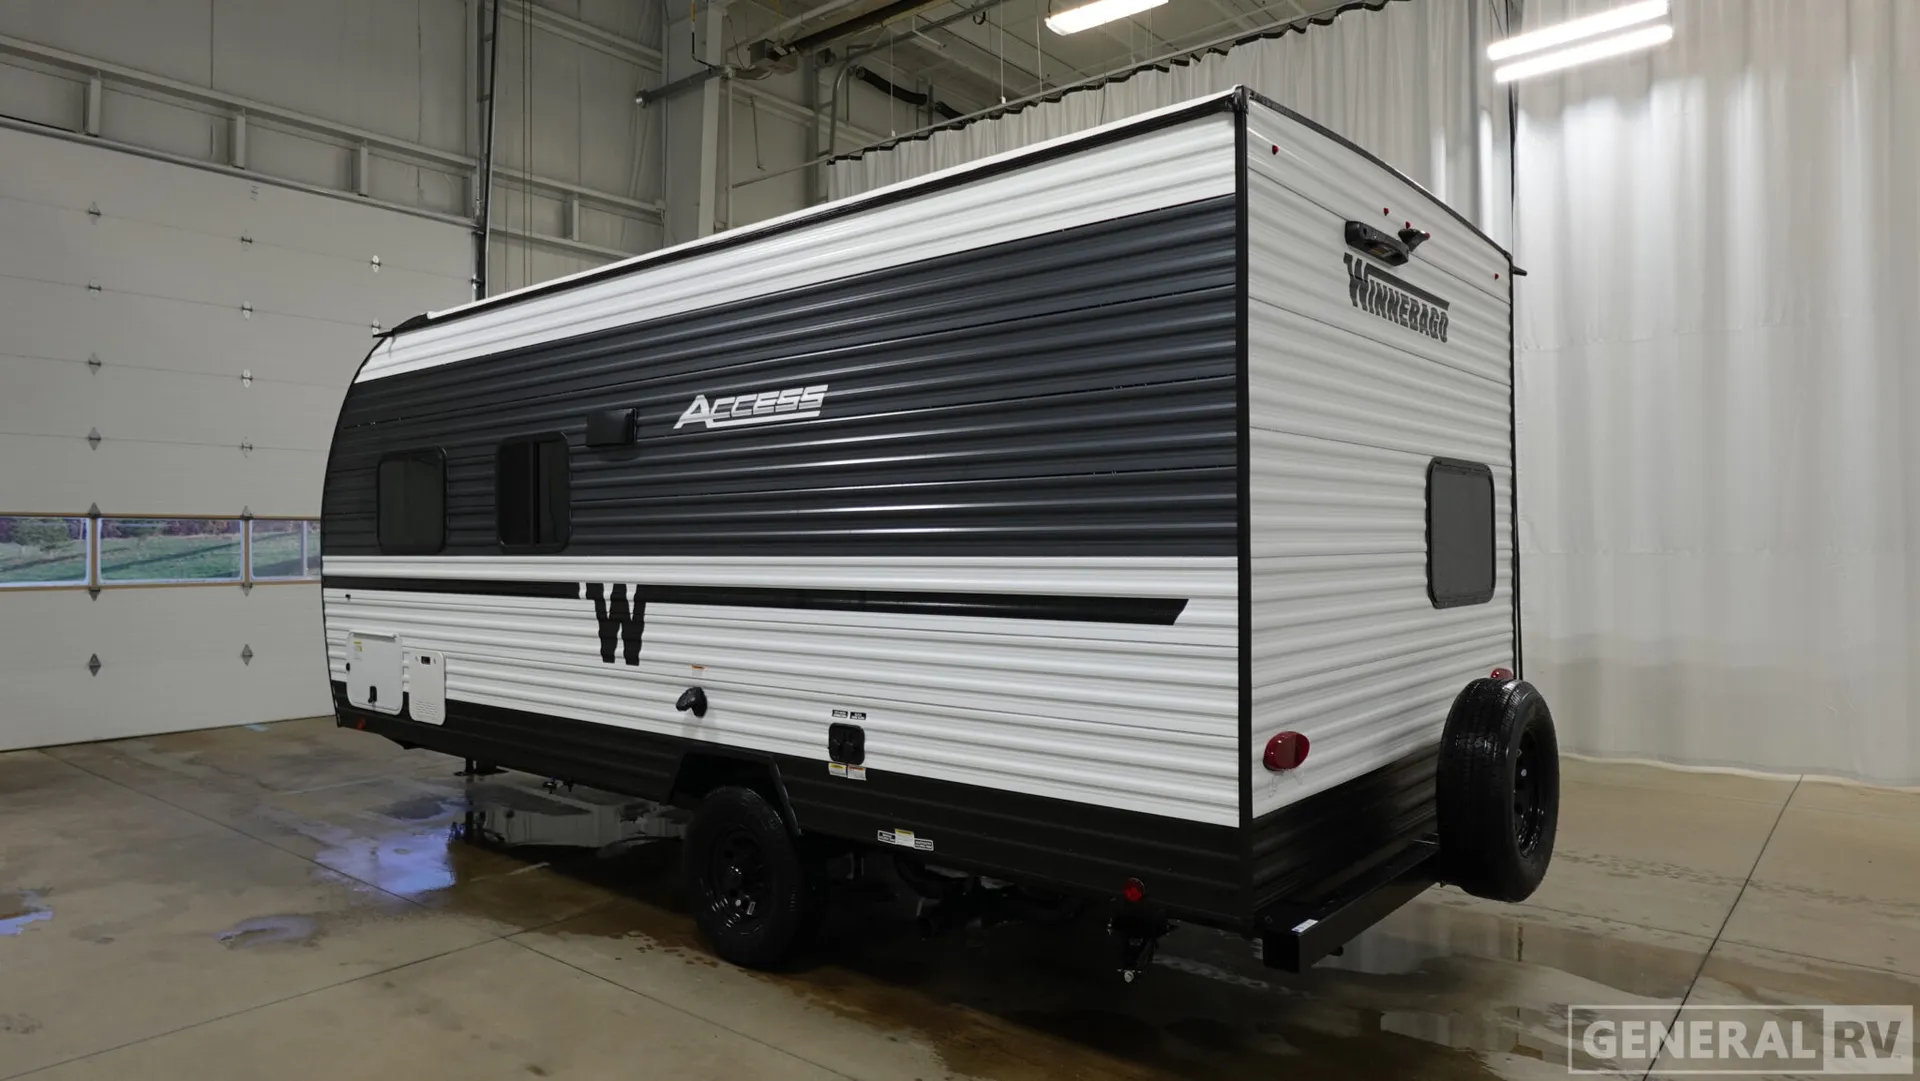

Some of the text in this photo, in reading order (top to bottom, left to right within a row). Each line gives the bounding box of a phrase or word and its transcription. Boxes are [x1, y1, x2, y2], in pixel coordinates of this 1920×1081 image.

[1343, 252, 1449, 343] WINNEBAGO
[673, 384, 828, 429] ACCESS
[586, 583, 646, 667] W
